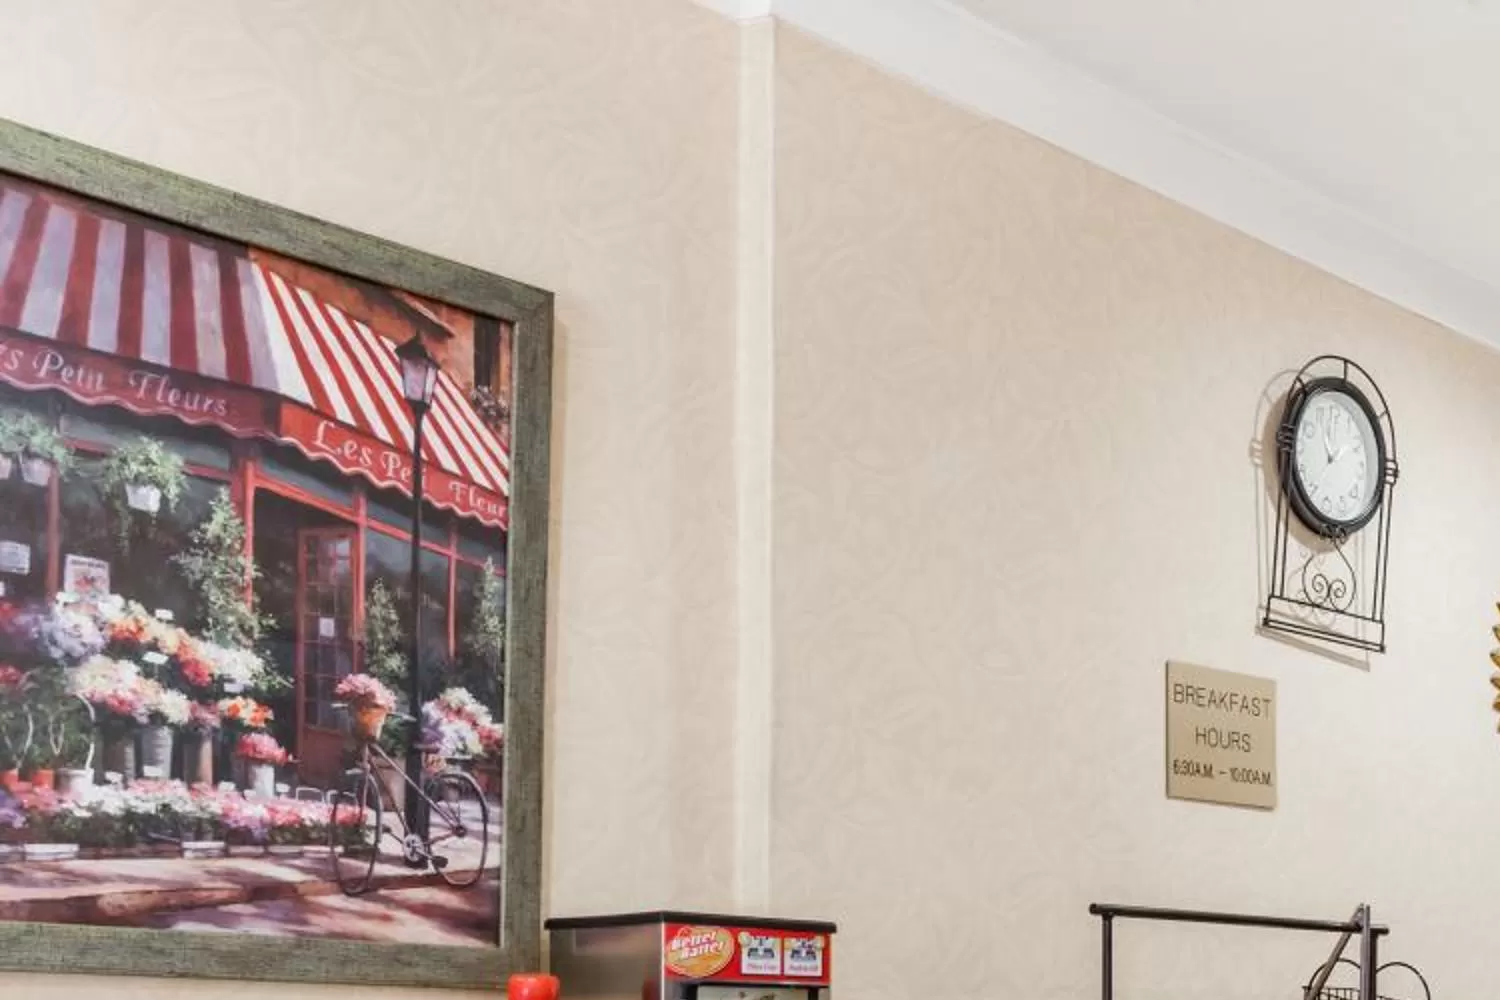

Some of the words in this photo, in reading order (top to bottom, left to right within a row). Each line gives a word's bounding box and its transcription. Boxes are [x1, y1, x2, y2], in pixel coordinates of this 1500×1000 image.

[129, 370, 227, 416] Fleurs
[312, 420, 373, 467] Les
[1173, 683, 1272, 720] BREAKFAST
[1195, 726, 1252, 753] HOURS
